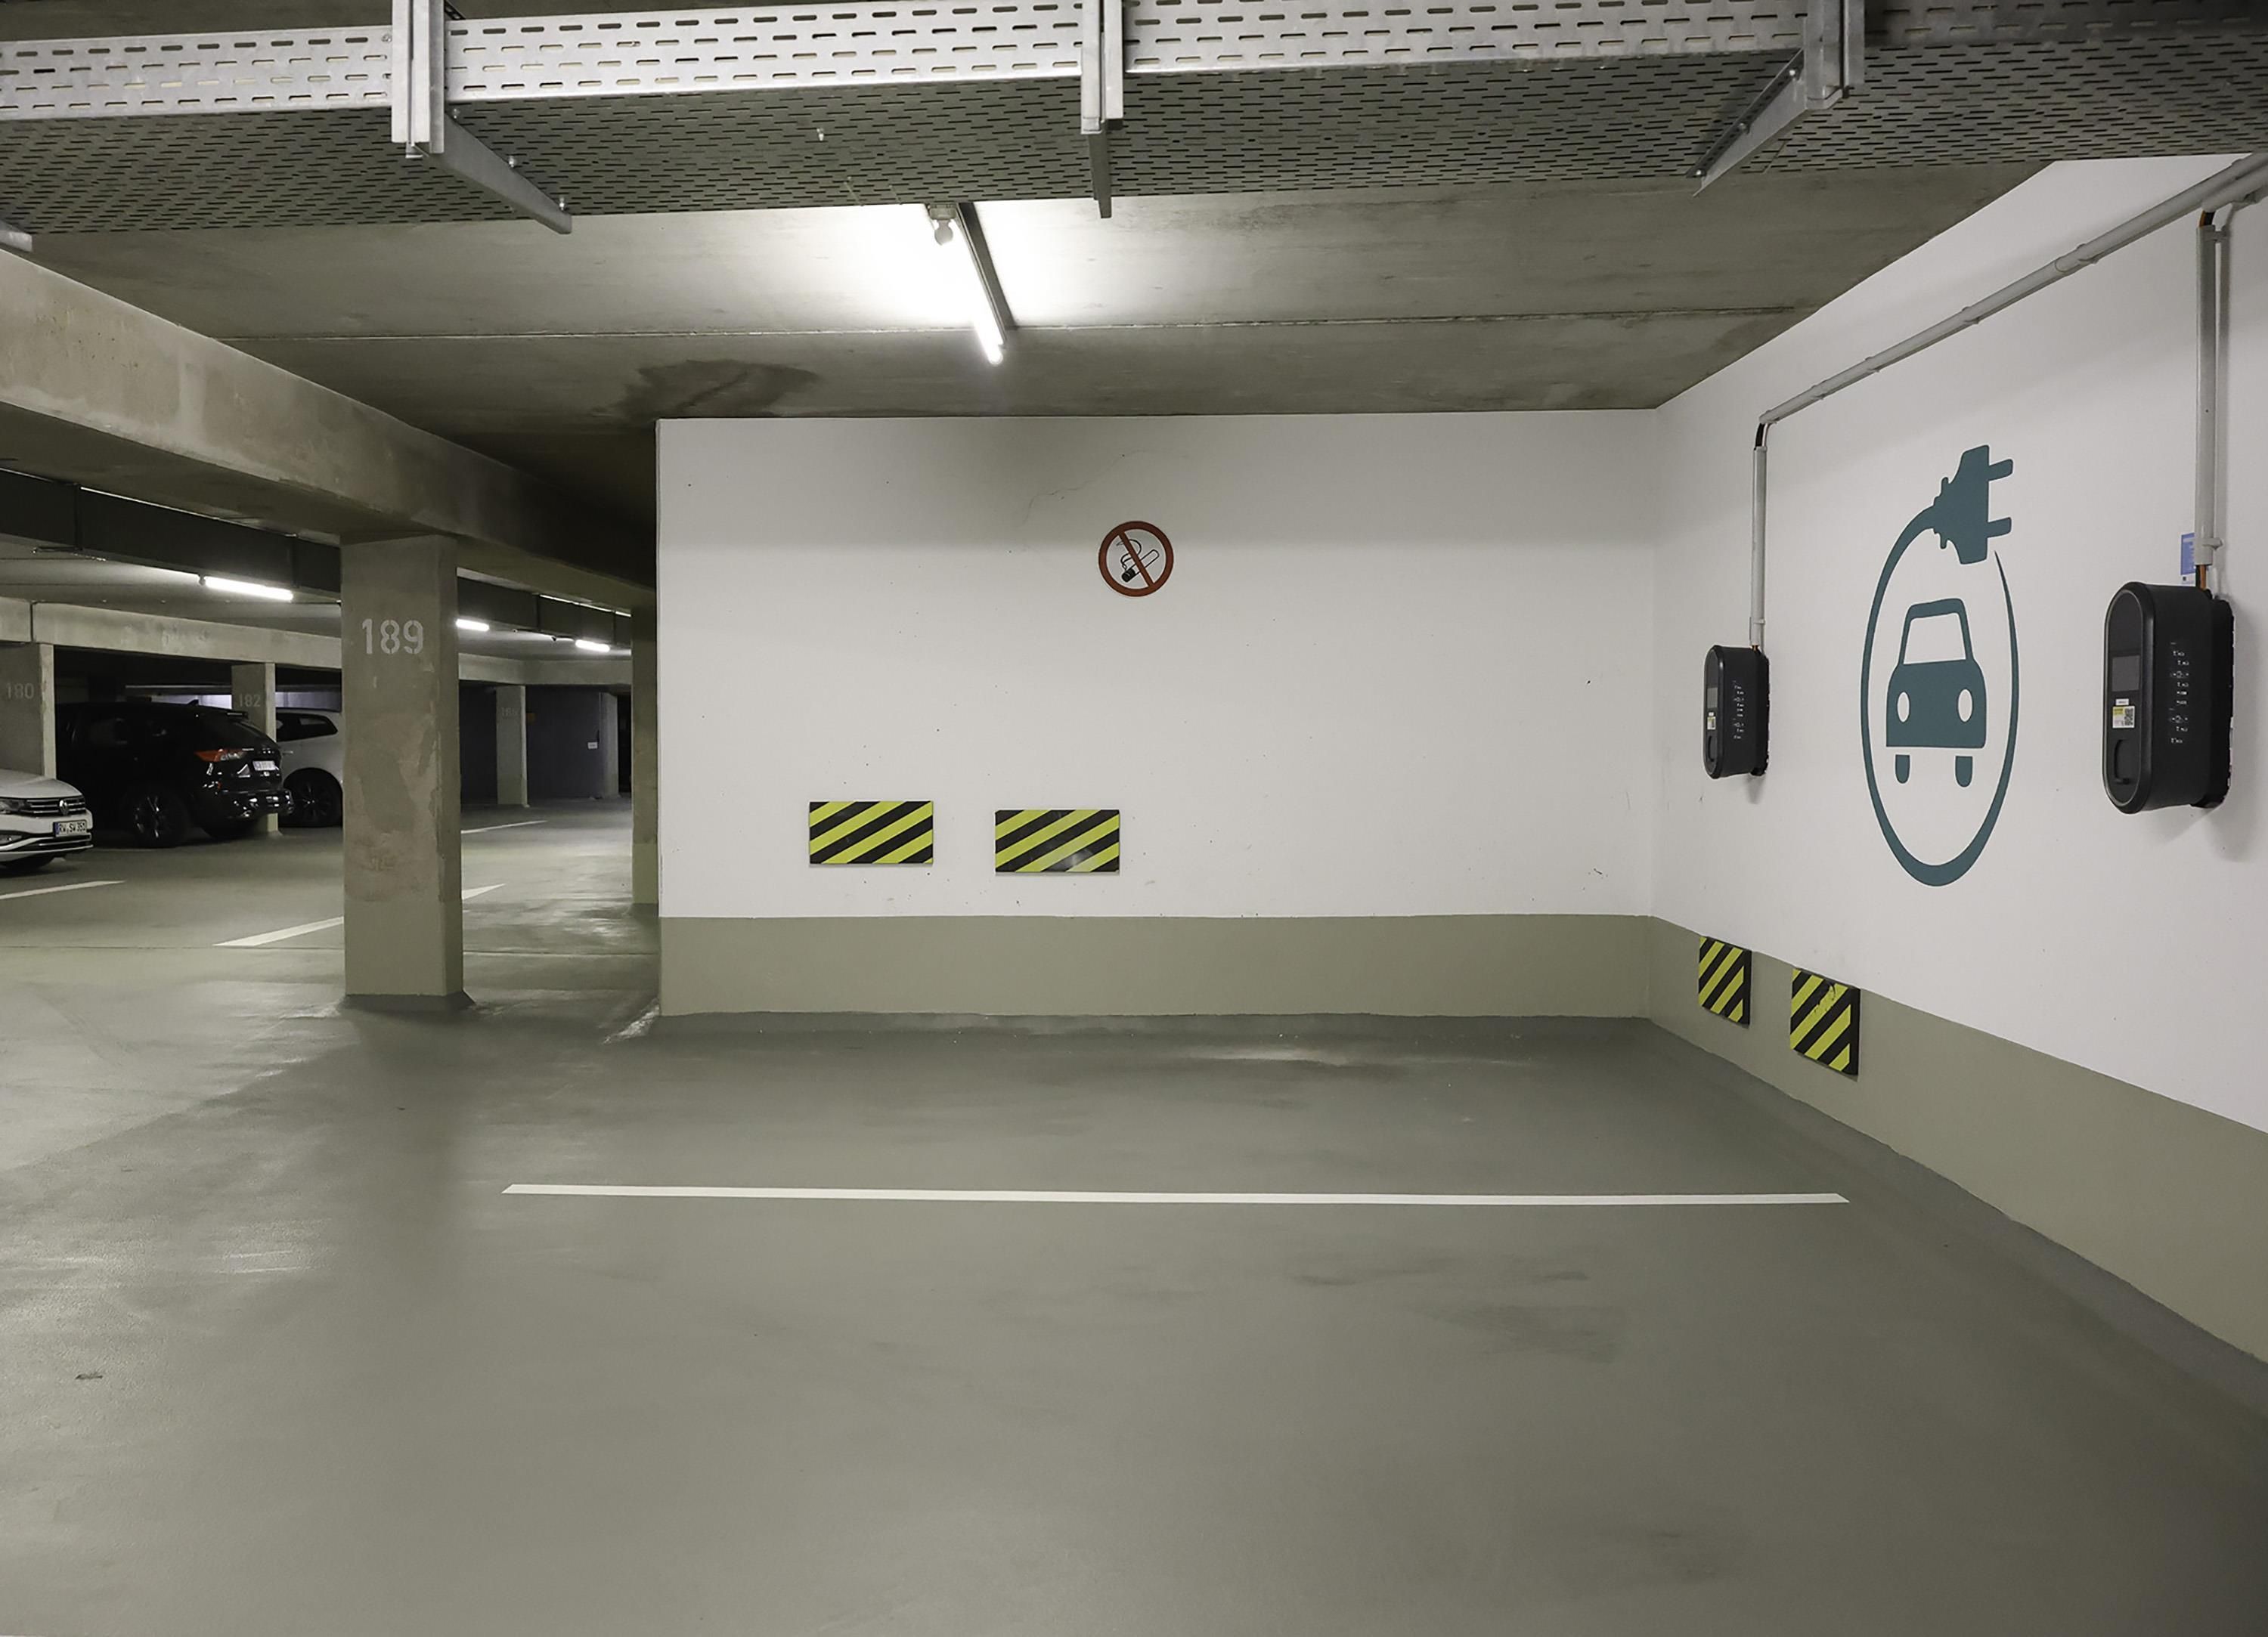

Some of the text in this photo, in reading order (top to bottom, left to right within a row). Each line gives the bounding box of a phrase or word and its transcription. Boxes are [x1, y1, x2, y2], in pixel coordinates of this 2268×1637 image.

[362, 619, 424, 654] 189
[6, 682, 35, 699] 180
[239, 694, 261, 707] 182
